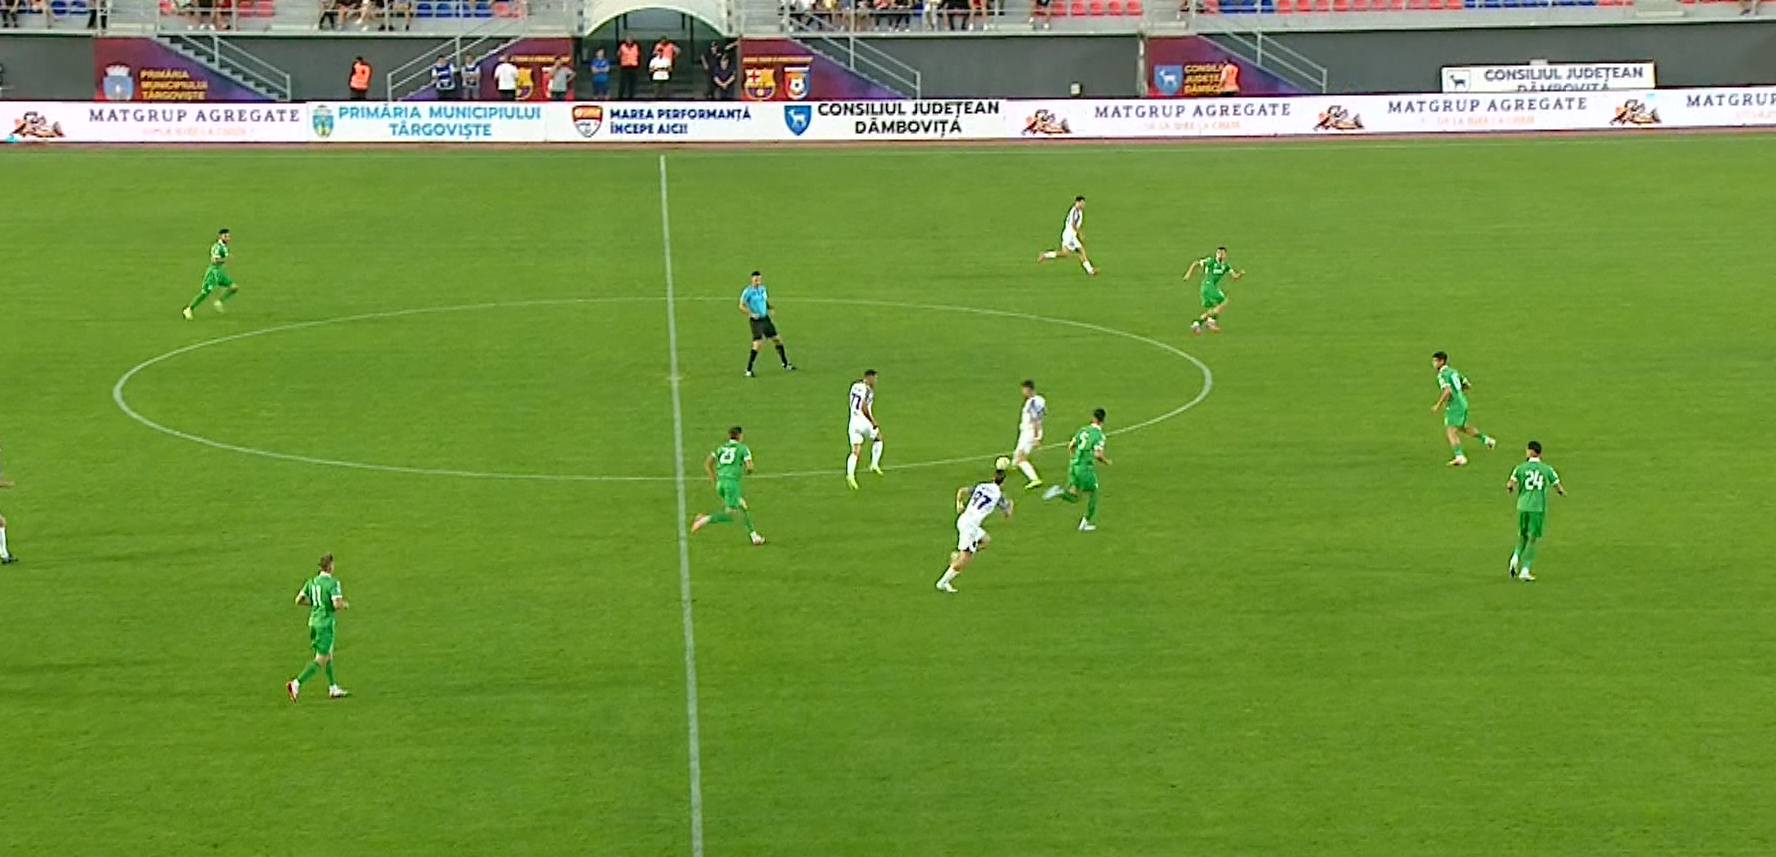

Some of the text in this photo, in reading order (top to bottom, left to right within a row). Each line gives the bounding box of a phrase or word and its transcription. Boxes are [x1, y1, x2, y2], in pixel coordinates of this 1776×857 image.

[1484, 68, 1562, 82] CONSILIUL
[429, 106, 541, 119] MUNICIPIULUI
[818, 101, 999, 118] CONSILIUL JUDEȚEAN
[1095, 103, 1291, 118] MATGRUP AGREGATE
[1387, 97, 1587, 113] MATGRUP AGREGATE
[89, 109, 299, 122] MATGRUP AGREGATE
[610, 109, 654, 119] MAREA
[1525, 469, 1544, 490] 24
[311, 584, 322, 606] 11
